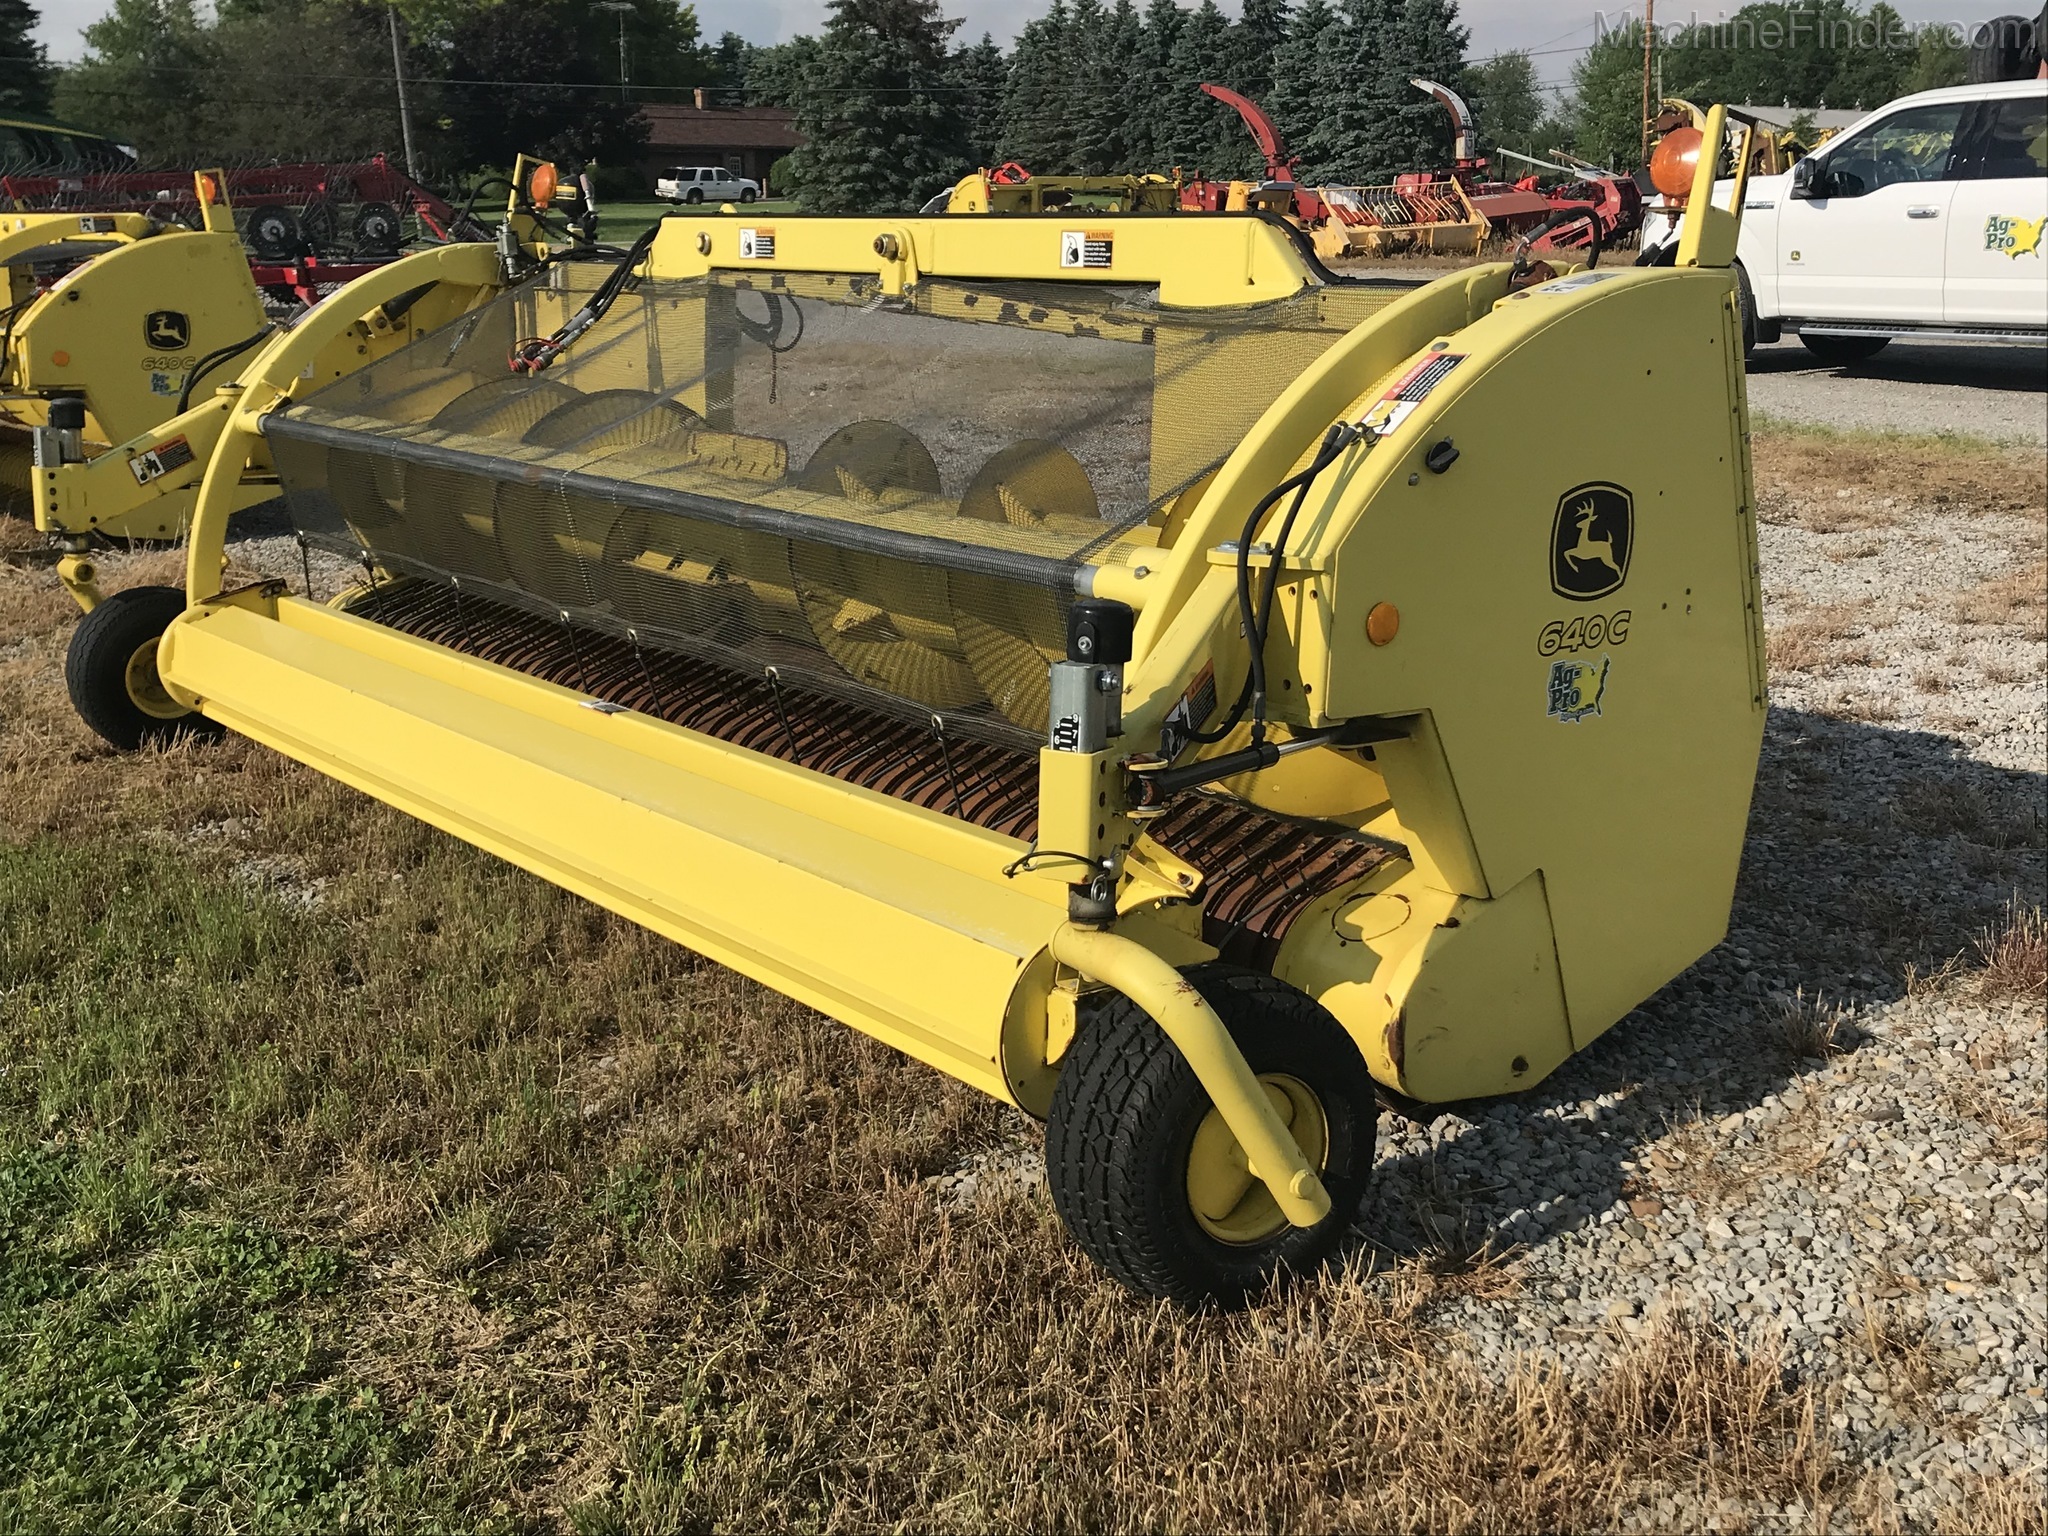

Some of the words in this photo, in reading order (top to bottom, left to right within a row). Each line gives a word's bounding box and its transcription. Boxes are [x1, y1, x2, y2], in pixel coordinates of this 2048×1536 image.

[1985, 216, 2016, 235] Ag-
[1985, 234, 2015, 249] Pro
[141, 356, 196, 371] 640C
[1400, 359, 1432, 385] DANGER
[1537, 610, 1632, 657] 640C
[1549, 661, 1582, 691] Ag-
[1548, 688, 1580, 714] Pro
[1054, 735, 1060, 745] 6
[1071, 730, 1078, 739] 7
